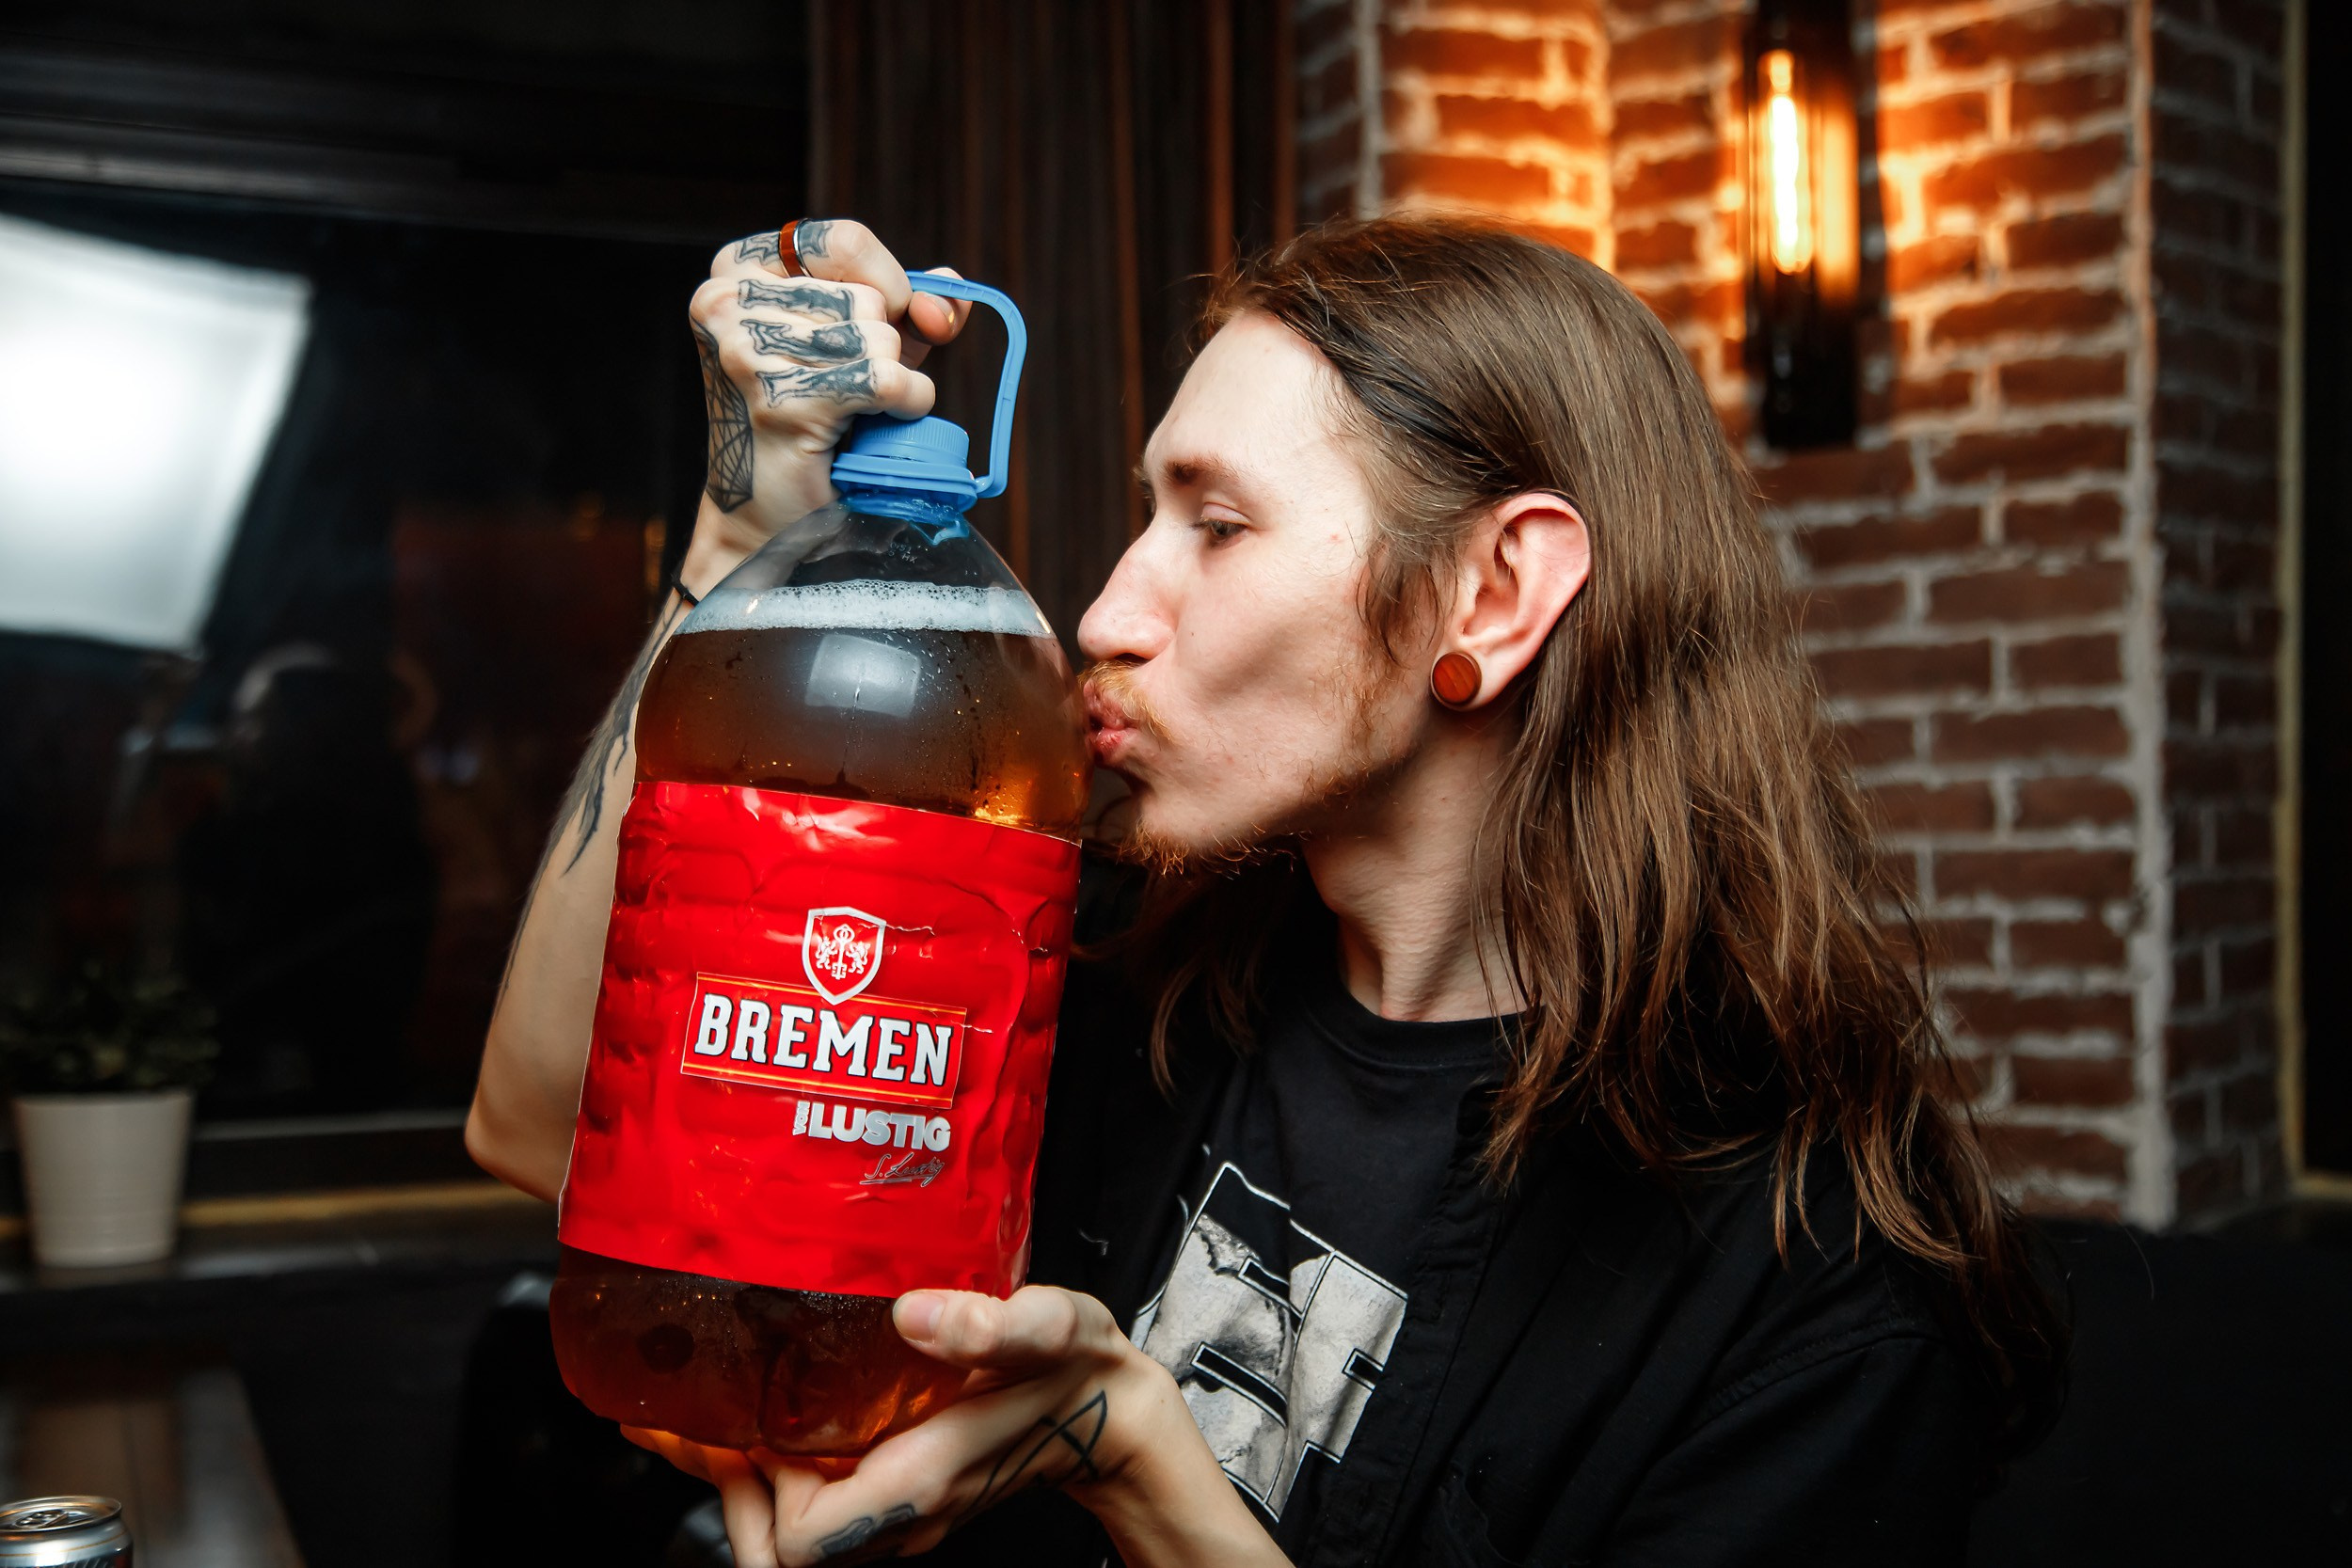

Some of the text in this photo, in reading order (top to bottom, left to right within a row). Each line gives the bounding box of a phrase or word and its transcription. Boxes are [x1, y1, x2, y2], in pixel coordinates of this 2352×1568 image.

[694, 992, 954, 1086] BREMEN
[793, 1101, 810, 1135] VON
[808, 1101, 951, 1152] LUSTIG
